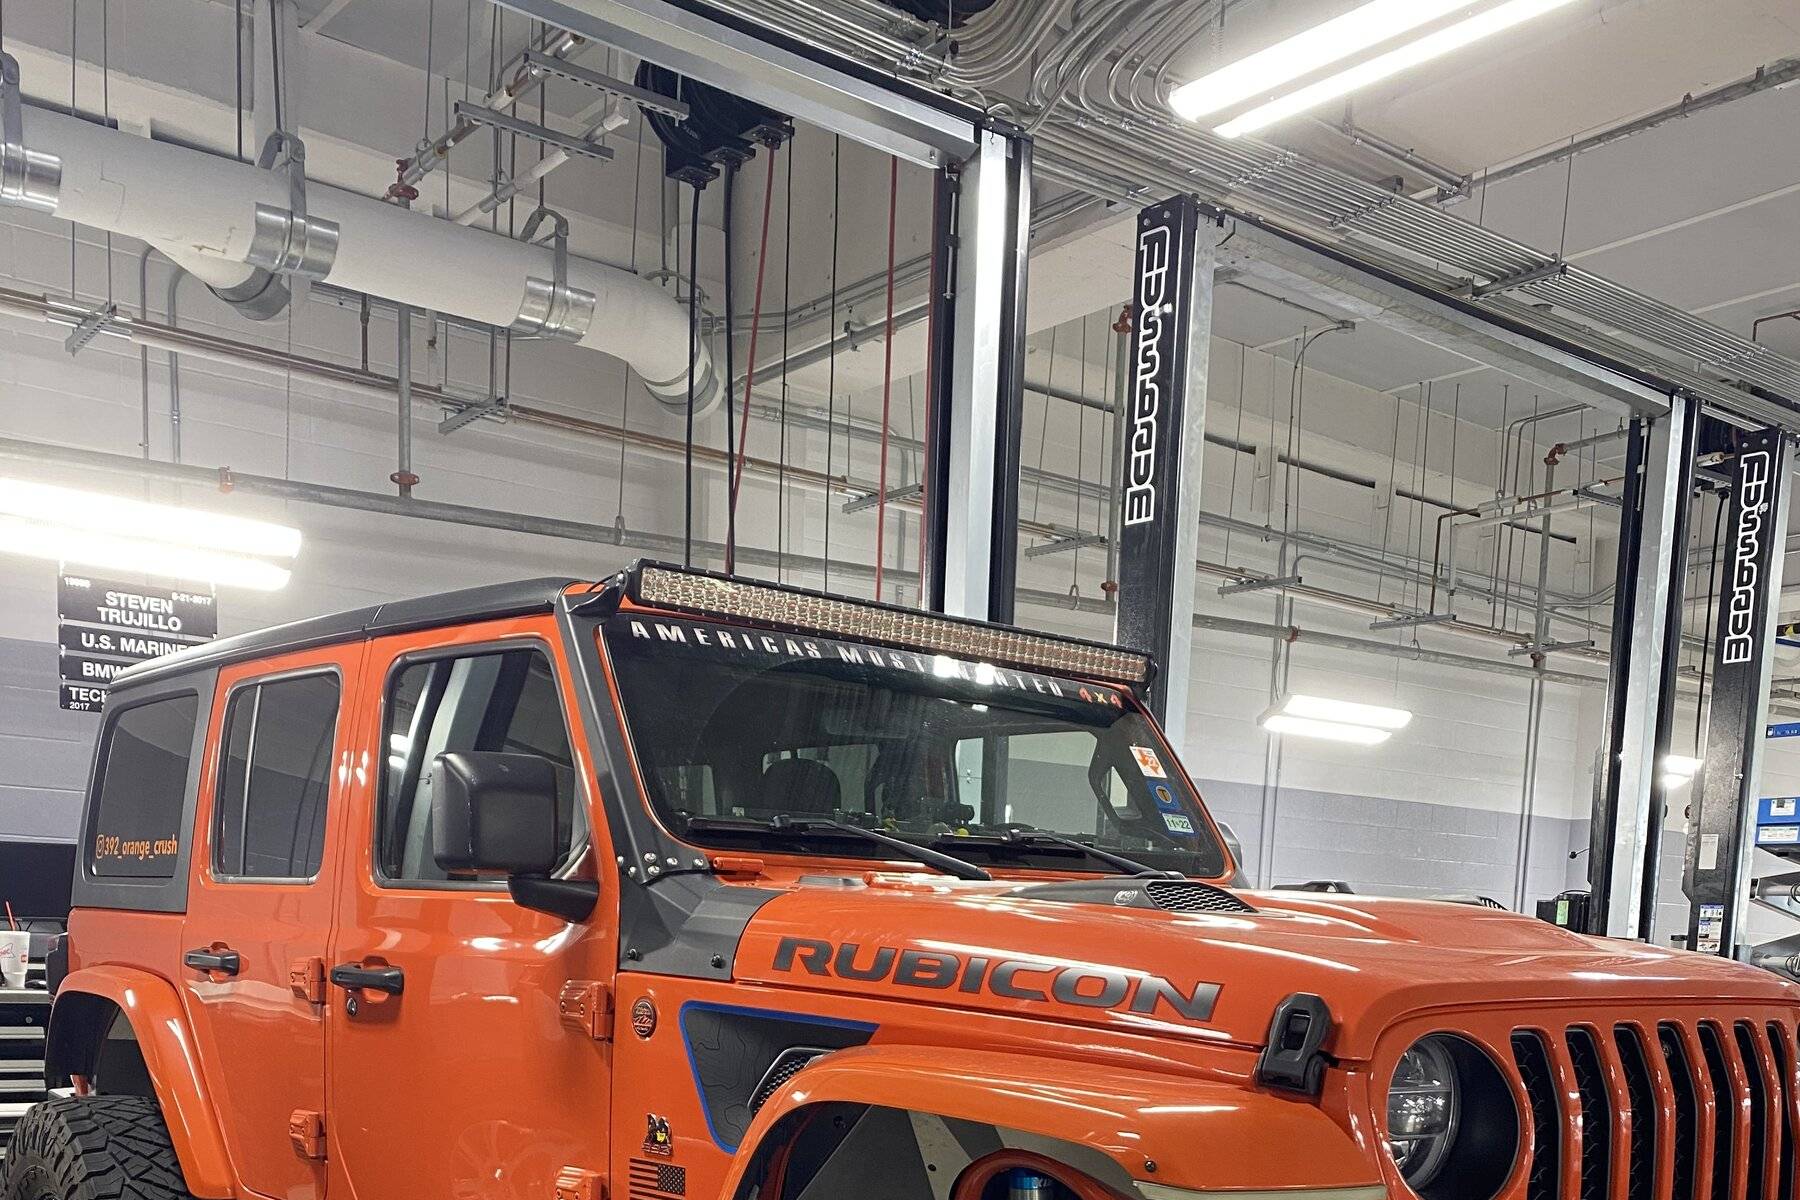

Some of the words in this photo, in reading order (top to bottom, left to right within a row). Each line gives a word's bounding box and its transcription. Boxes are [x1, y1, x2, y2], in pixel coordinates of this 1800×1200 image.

[105, 591, 174, 614] STEVEN
[97, 606, 182, 632] TRUJILLO
[81, 632, 116, 651] U.S.
[120, 637, 196, 656] MARINE
[630, 620, 822, 659] AMERICAS
[836, 645, 925, 673] MOST
[934, 655, 1064, 698] ANTED
[70, 701, 90, 711] 2017
[771, 936, 1225, 1023] RUBICON
